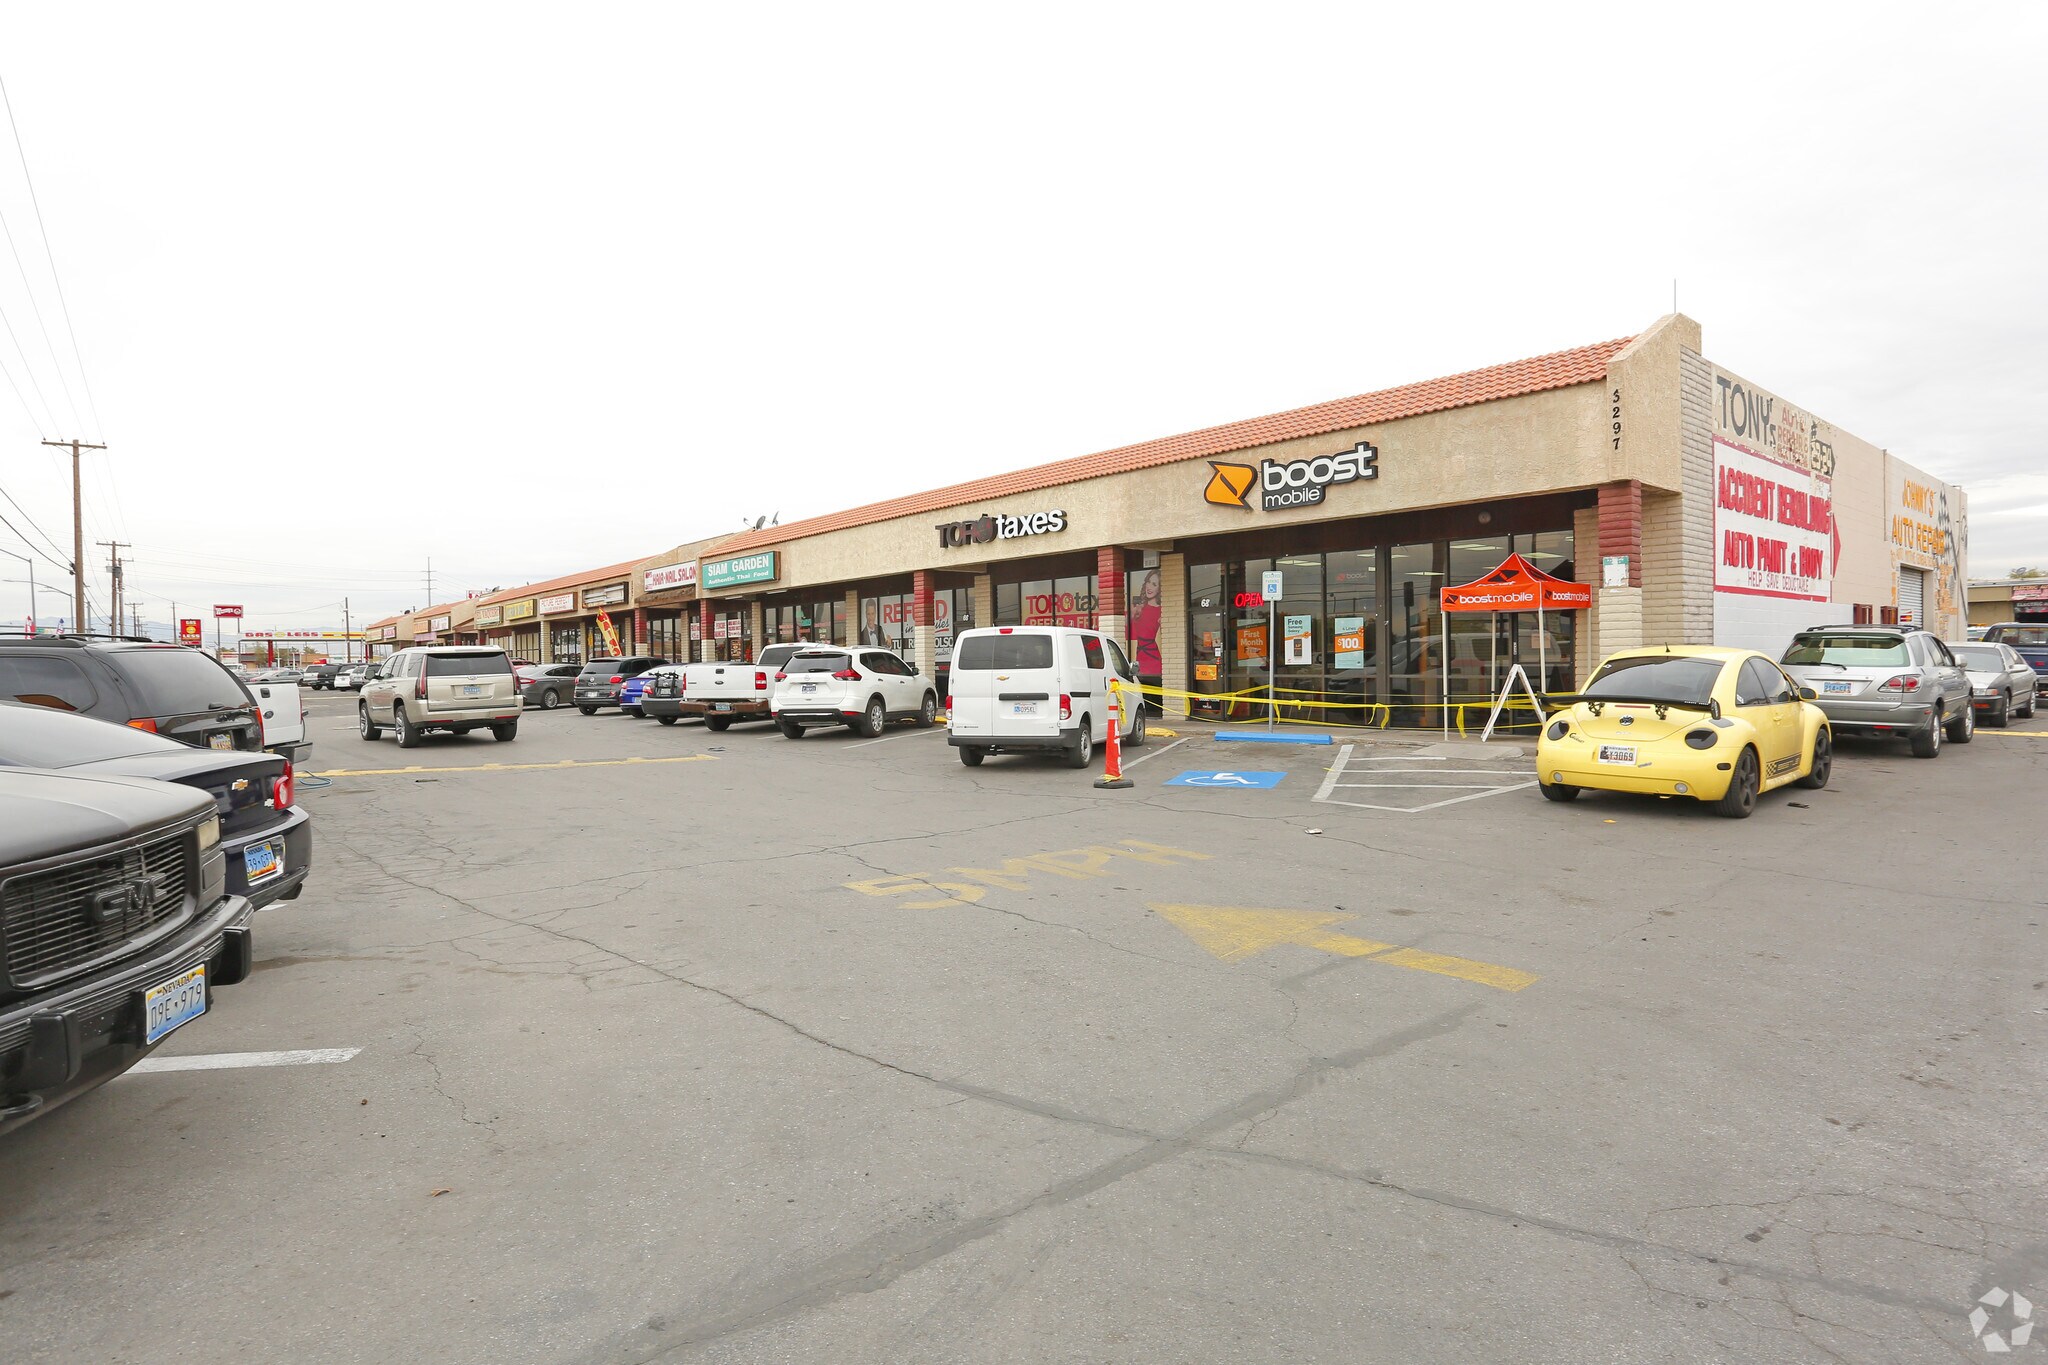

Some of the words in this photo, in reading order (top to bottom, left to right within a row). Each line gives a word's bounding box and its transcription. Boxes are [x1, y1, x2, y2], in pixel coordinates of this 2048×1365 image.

[1612, 389, 1621, 450] 5297
[1262, 443, 1375, 491] boost
[1265, 486, 1321, 507] mobile
[1718, 465, 1776, 520] ACCIDENT
[996, 509, 1067, 539] taxes
[1892, 513, 1914, 549] AUTO
[1723, 529, 1754, 569] AUTO
[1757, 536, 1788, 574] PAINT
[1799, 545, 1823, 579] BODY
[708, 563, 728, 577] SIAM
[732, 555, 769, 572] GARDEN
[708, 576, 735, 585] Authentic
[1747, 570, 1762, 587] HELP
[1766, 573, 1779, 589] SAVE
[1200, 599, 1210, 607] 68
[1234, 592, 1264, 608] OPEN
[1459, 593, 1534, 604] boostmobile
[1240, 638, 1264, 646] Month
[1337, 637, 1359, 649] $100
[162, 974, 191, 996] NEVADA
